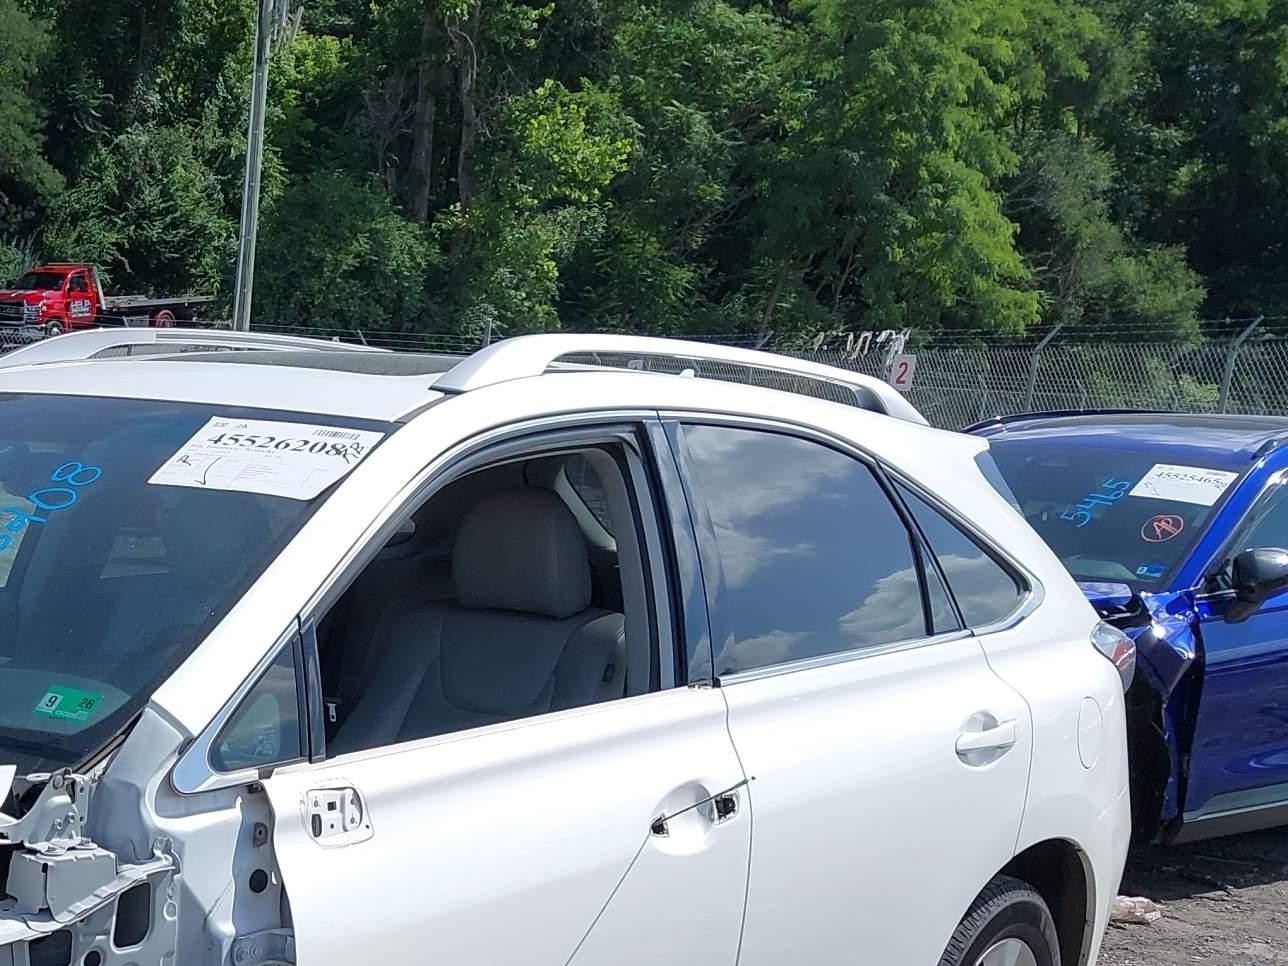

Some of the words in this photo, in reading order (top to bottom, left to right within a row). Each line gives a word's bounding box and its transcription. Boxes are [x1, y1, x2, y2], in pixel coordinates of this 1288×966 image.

[895, 361, 909, 385] 2
[207, 432, 346, 457] 45526208
[1060, 478, 1133, 528] 5465
[45, 695, 58, 707] 9
[78, 697, 96, 710] 26
